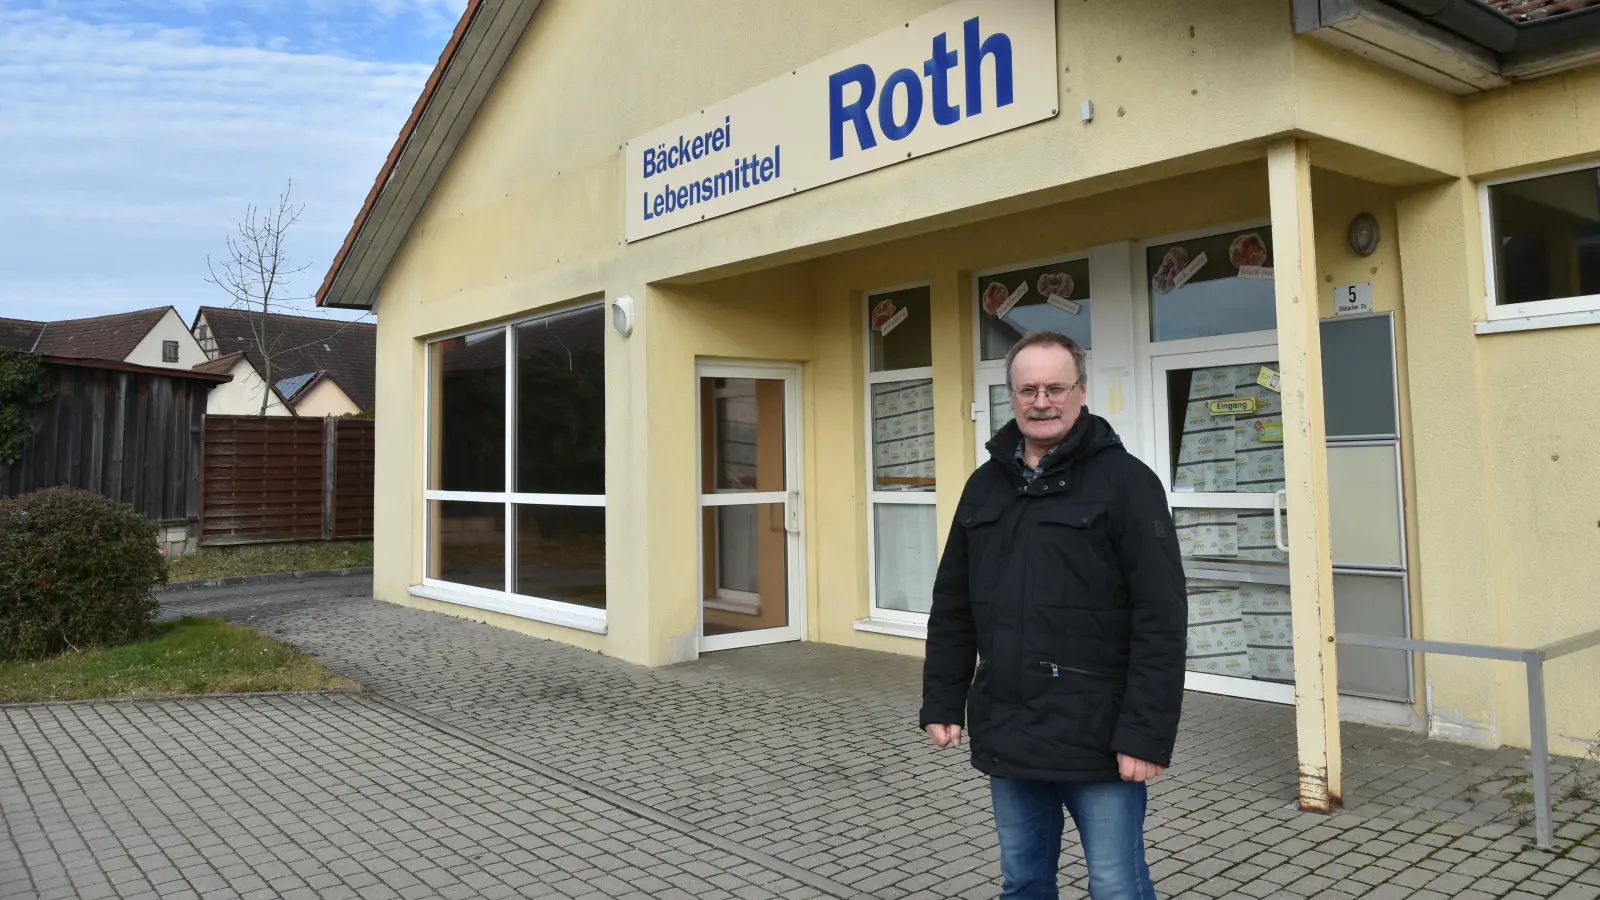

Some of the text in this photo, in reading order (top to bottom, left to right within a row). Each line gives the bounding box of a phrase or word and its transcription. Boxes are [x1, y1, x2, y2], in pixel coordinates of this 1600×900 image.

[828, 16, 1015, 161] Roth
[643, 116, 731, 178] Bäckerei
[643, 145, 781, 221] Lebensmittel
[1348, 285, 1356, 303] 5
[1216, 402, 1247, 411] Eingang
